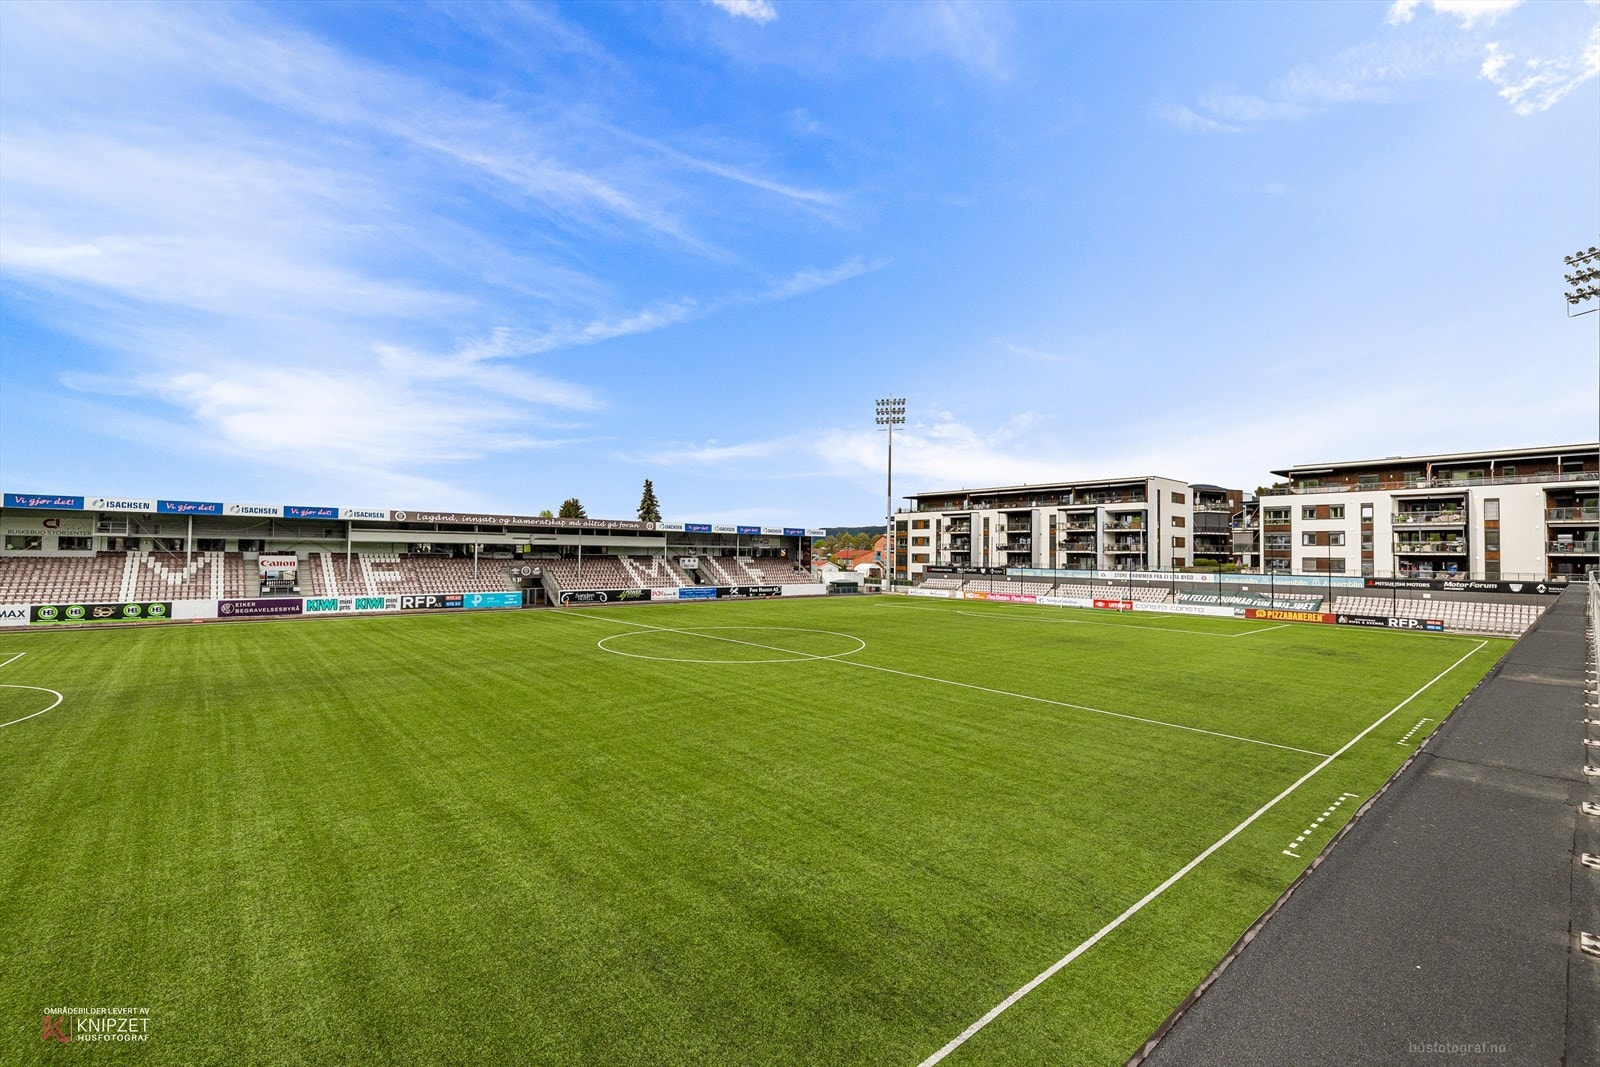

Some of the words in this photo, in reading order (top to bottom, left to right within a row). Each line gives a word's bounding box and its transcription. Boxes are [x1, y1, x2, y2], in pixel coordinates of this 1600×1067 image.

[29, 497, 52, 506] gjør
[53, 498, 74, 506] det!
[106, 501, 150, 509] ISACHSEN
[241, 506, 278, 514] ISACHSEN
[462, 515, 497, 523] innsats
[512, 517, 566, 527] kameratskap
[583, 519, 606, 527] alltid
[607, 521, 618, 529] gå
[619, 521, 640, 529] foran
[260, 559, 296, 567] Canon
[402, 595, 437, 608] RFP
[1190, 594, 1218, 602] FELLES
[306, 599, 338, 611] KIWI
[355, 597, 384, 609] KIWI
[235, 605, 300, 614] BEGRAVELSESBYRÅ
[1267, 611, 1323, 622] PIZZABAKEREN
[1388, 618, 1418, 628] RFP
